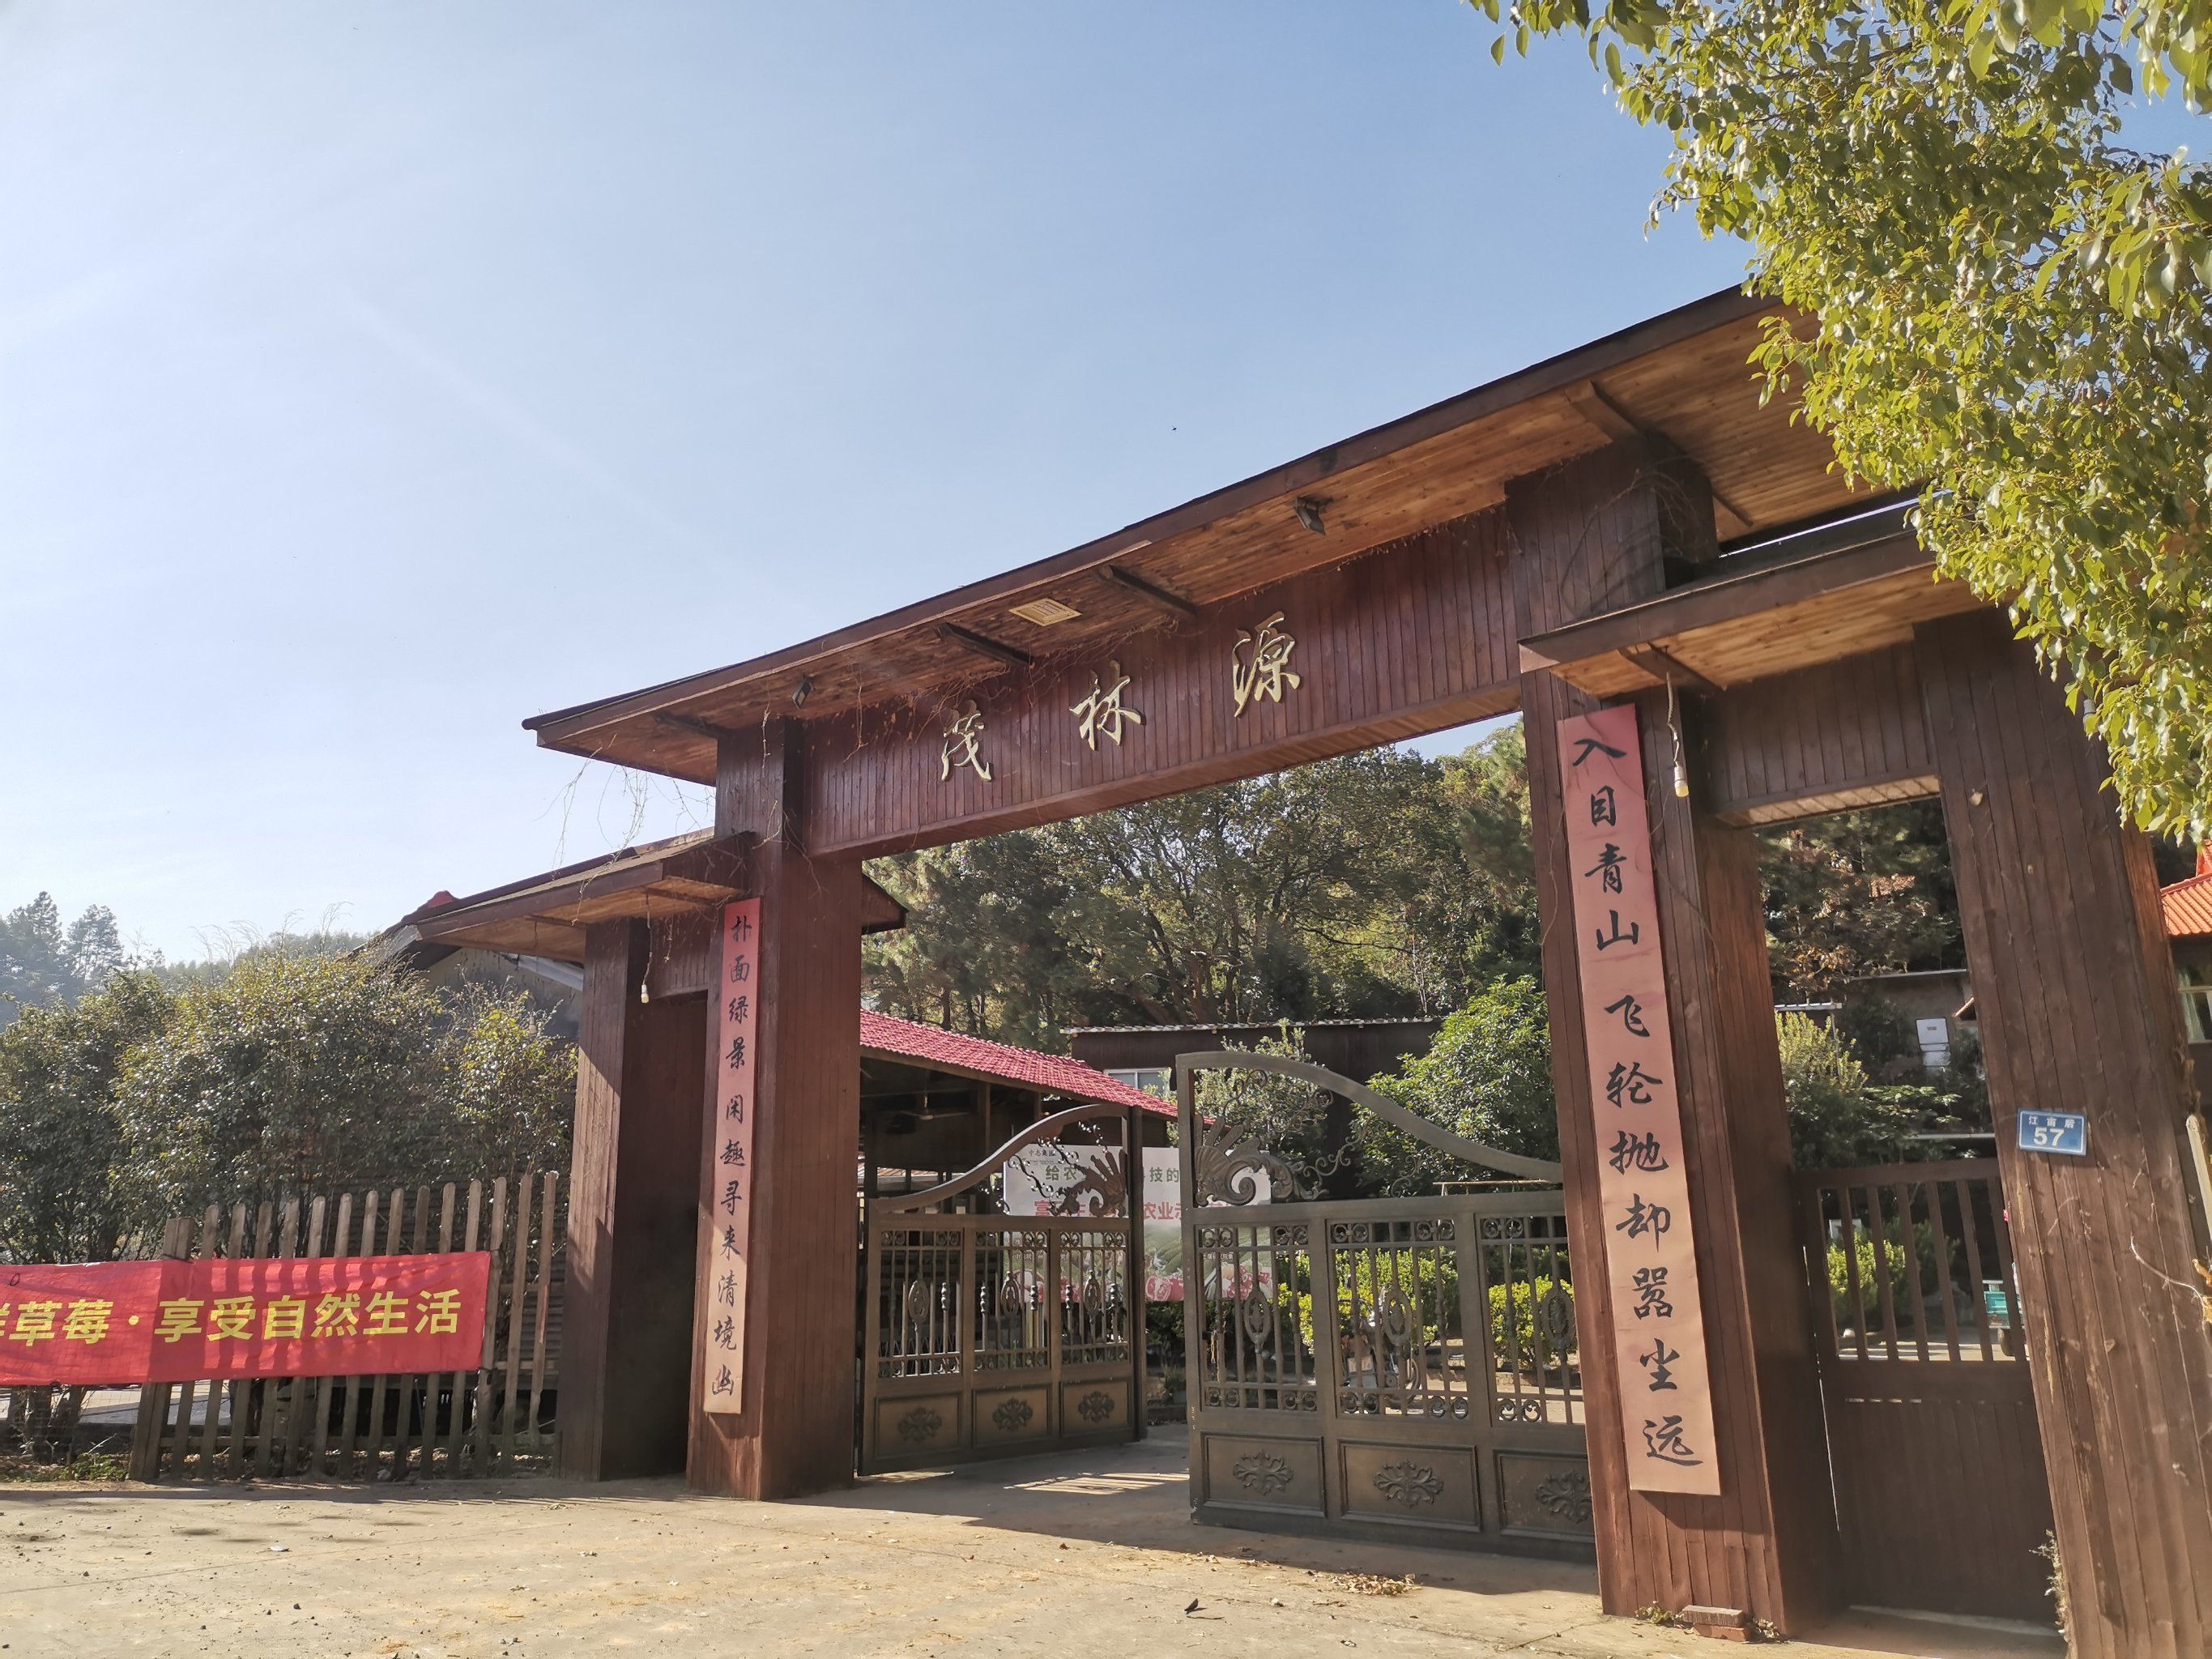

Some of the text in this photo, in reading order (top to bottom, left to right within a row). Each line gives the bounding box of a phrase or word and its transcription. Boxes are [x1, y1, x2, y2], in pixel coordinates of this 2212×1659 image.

[941, 611, 1300, 783] 茂林源
[1572, 738, 1704, 1467] 入目青山飞轮抛却嚣尘远
[2033, 1127, 2065, 1146] 57
[0, 1288, 461, 1346] 草莓·享受自然生活
